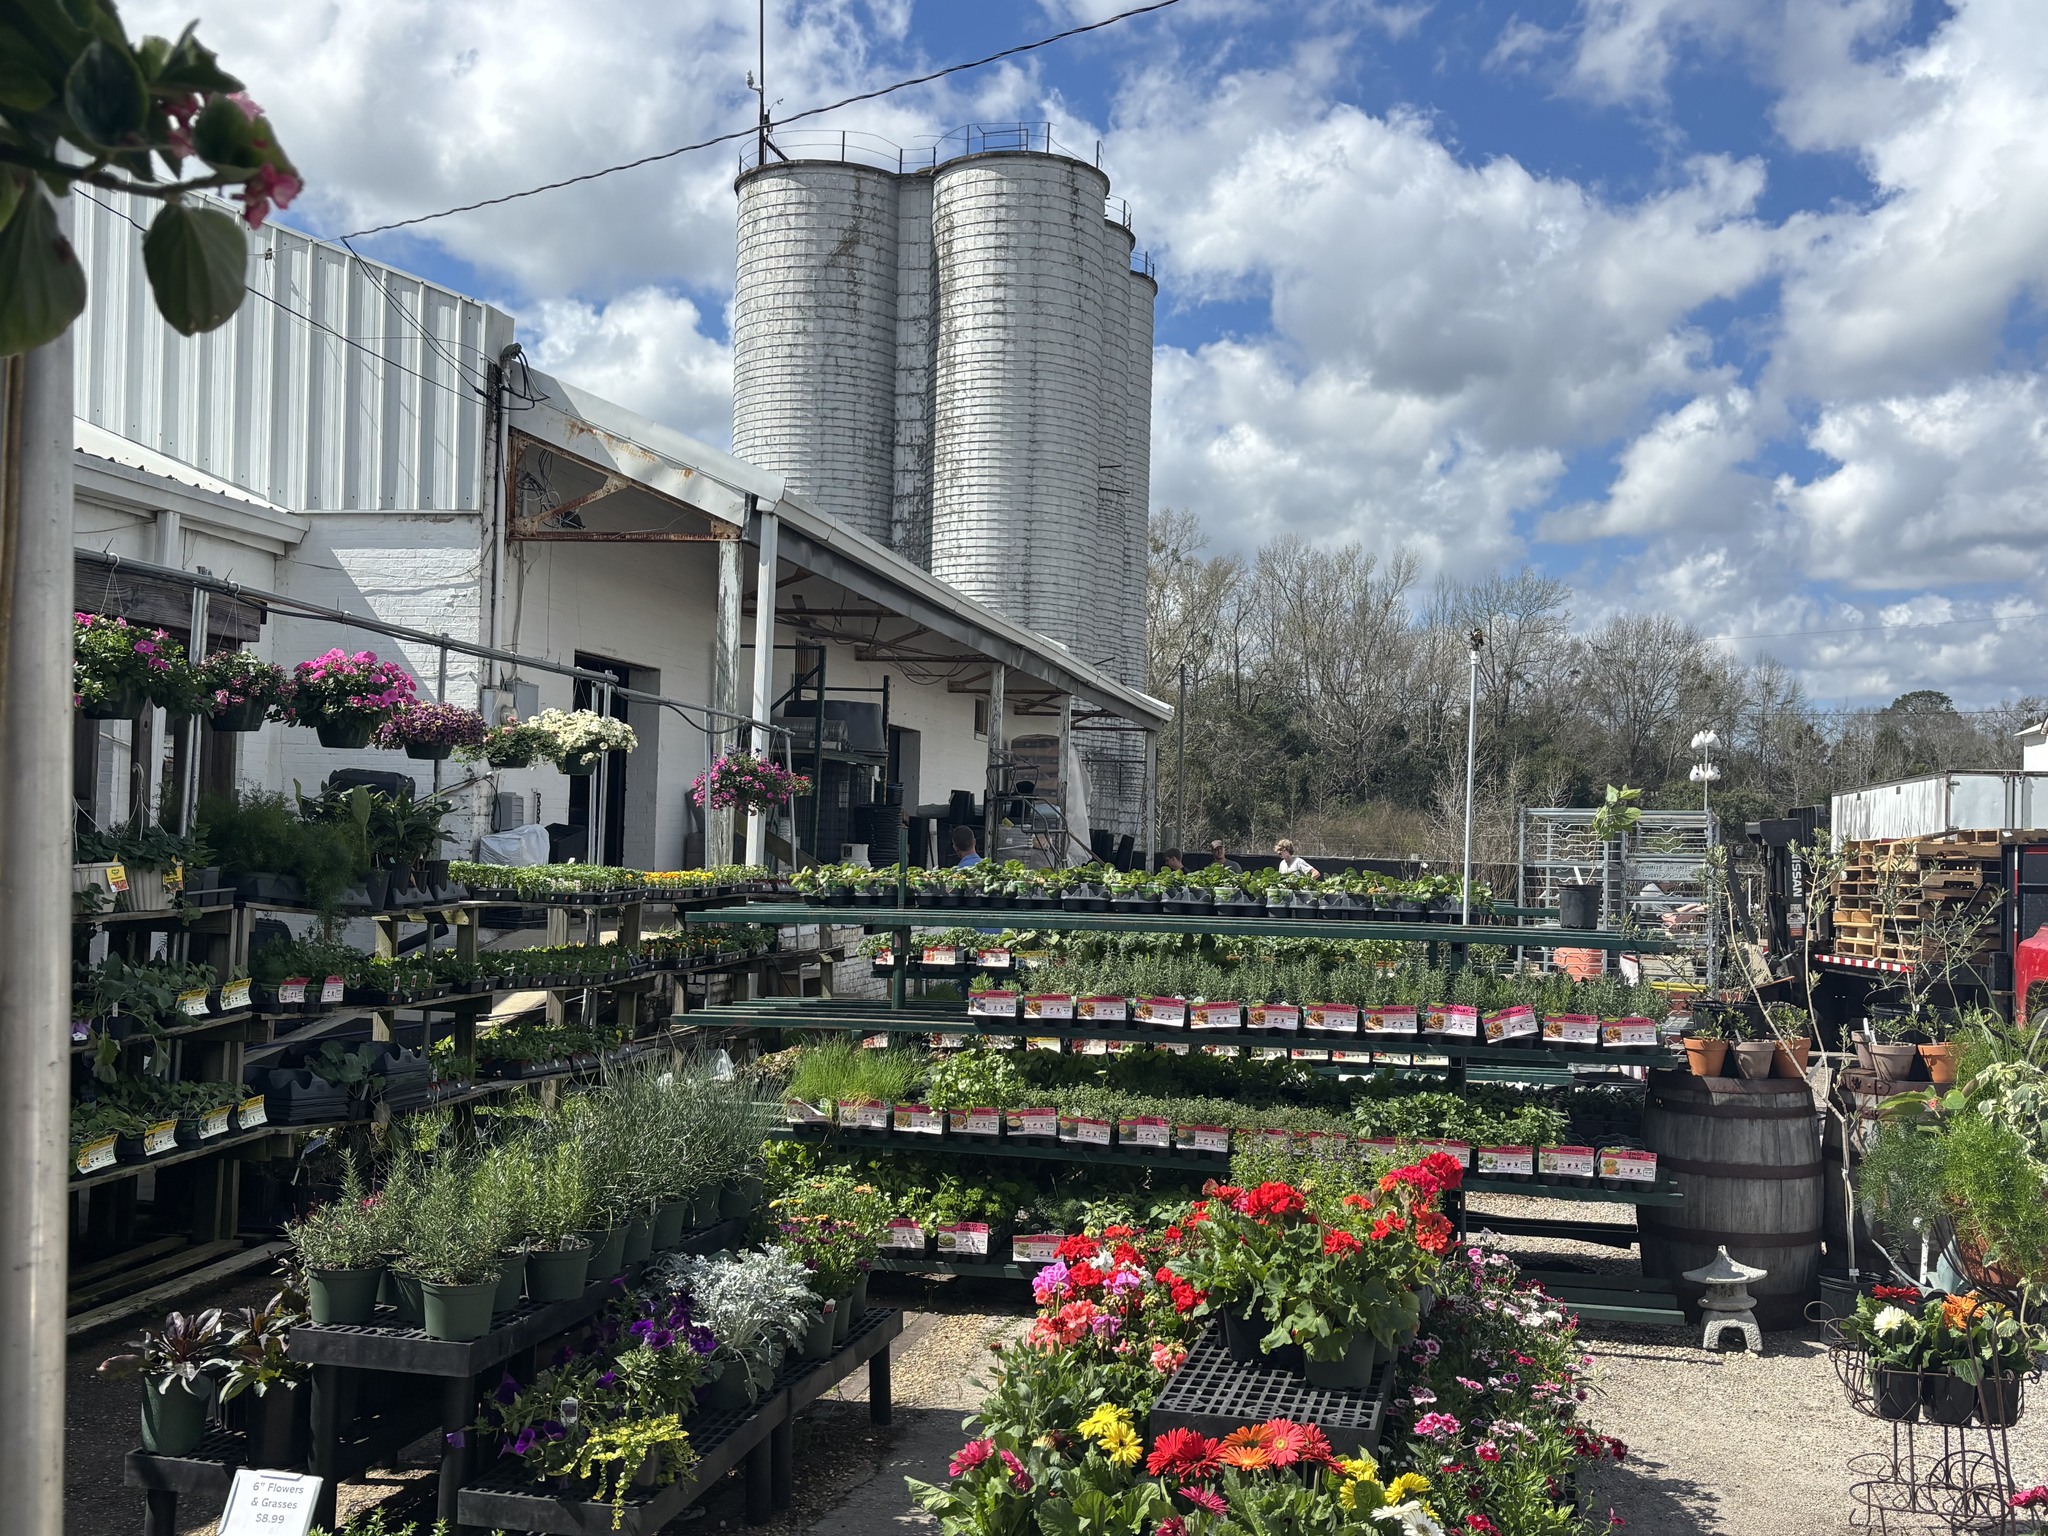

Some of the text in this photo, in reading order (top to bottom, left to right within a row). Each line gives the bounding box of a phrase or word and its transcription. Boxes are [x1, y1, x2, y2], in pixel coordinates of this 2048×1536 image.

[253, 1482, 304, 1494] 6" Flowers
[251, 1497, 298, 1509] & Grasses
[255, 1513, 285, 1524] $8.99
